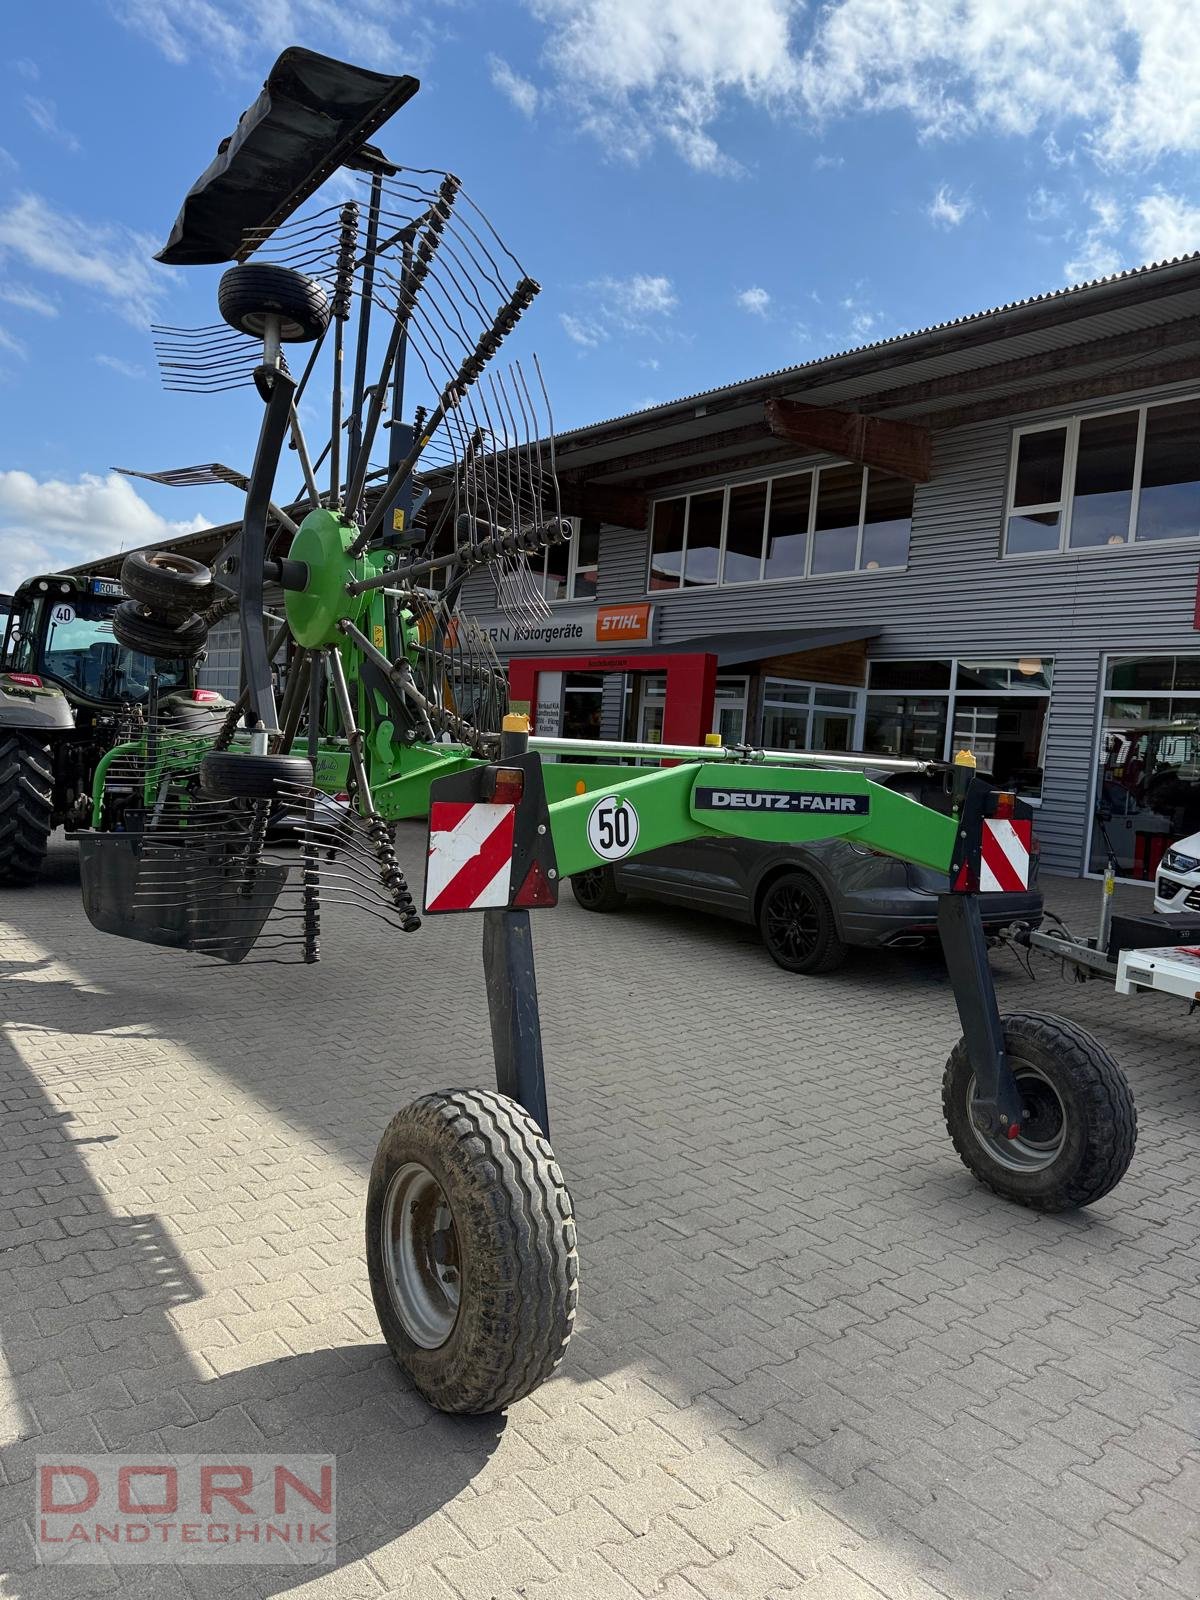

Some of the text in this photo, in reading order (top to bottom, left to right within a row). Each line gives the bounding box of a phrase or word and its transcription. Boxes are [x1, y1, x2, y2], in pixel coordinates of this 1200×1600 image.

[56, 607, 71, 621] 40
[601, 614, 641, 630] STIHL
[513, 623, 583, 643] Motorgeräte
[711, 792, 856, 811] DEUTZ-FAHR
[598, 808, 629, 849] 50
